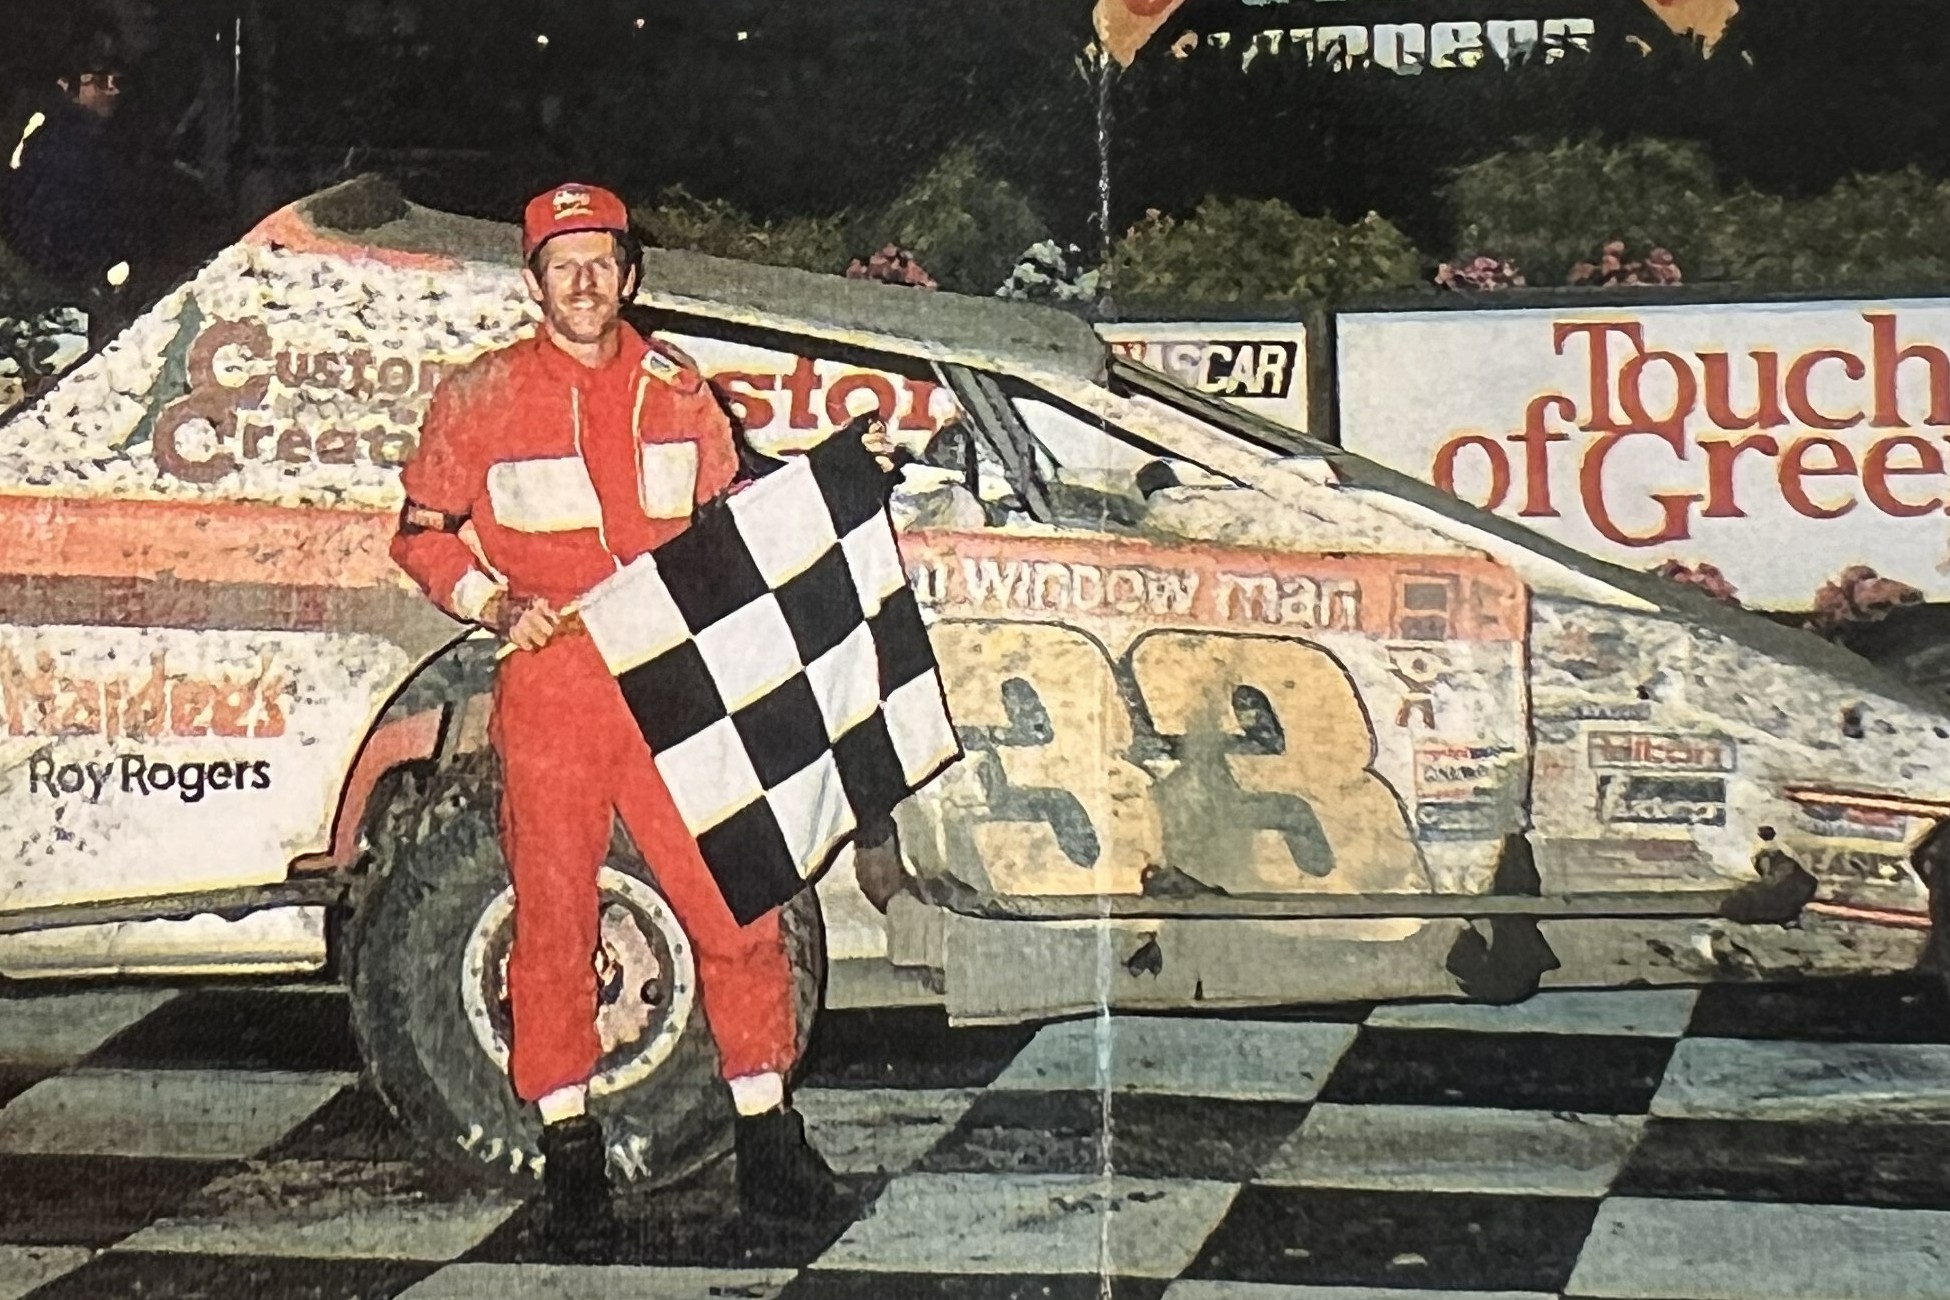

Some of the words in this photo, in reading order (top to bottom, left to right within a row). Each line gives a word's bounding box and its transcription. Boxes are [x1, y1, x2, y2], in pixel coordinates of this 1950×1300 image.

[1553, 313, 1950, 432] Touch
[1433, 394, 1577, 518] of
[1579, 430, 1950, 547] Gree
[29, 751, 113, 805] Roy
[121, 754, 271, 803] Rogers
